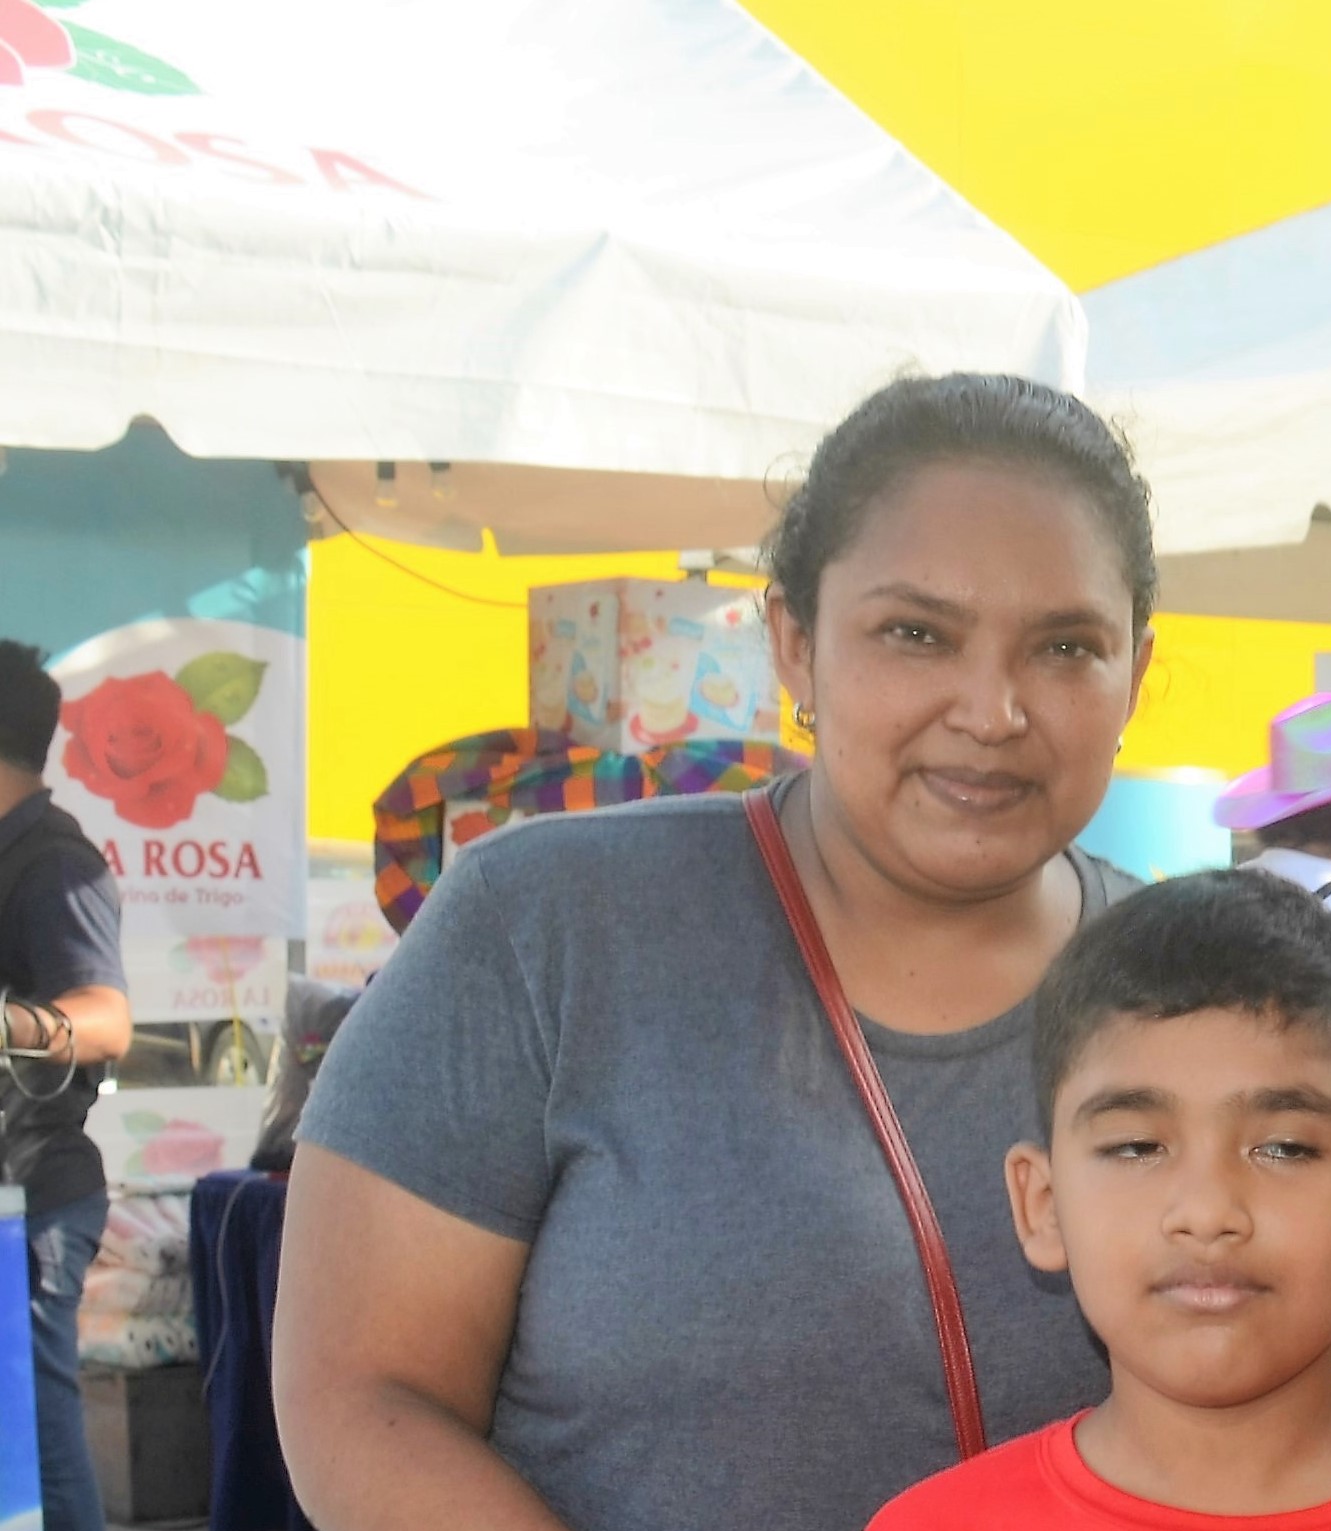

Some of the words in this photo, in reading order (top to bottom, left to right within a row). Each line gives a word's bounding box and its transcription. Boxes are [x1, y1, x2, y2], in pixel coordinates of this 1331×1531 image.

[0, 108, 444, 202] OSA
[101, 838, 126, 878] A
[143, 839, 264, 880] ROSA
[196, 888, 244, 908] Trigo
